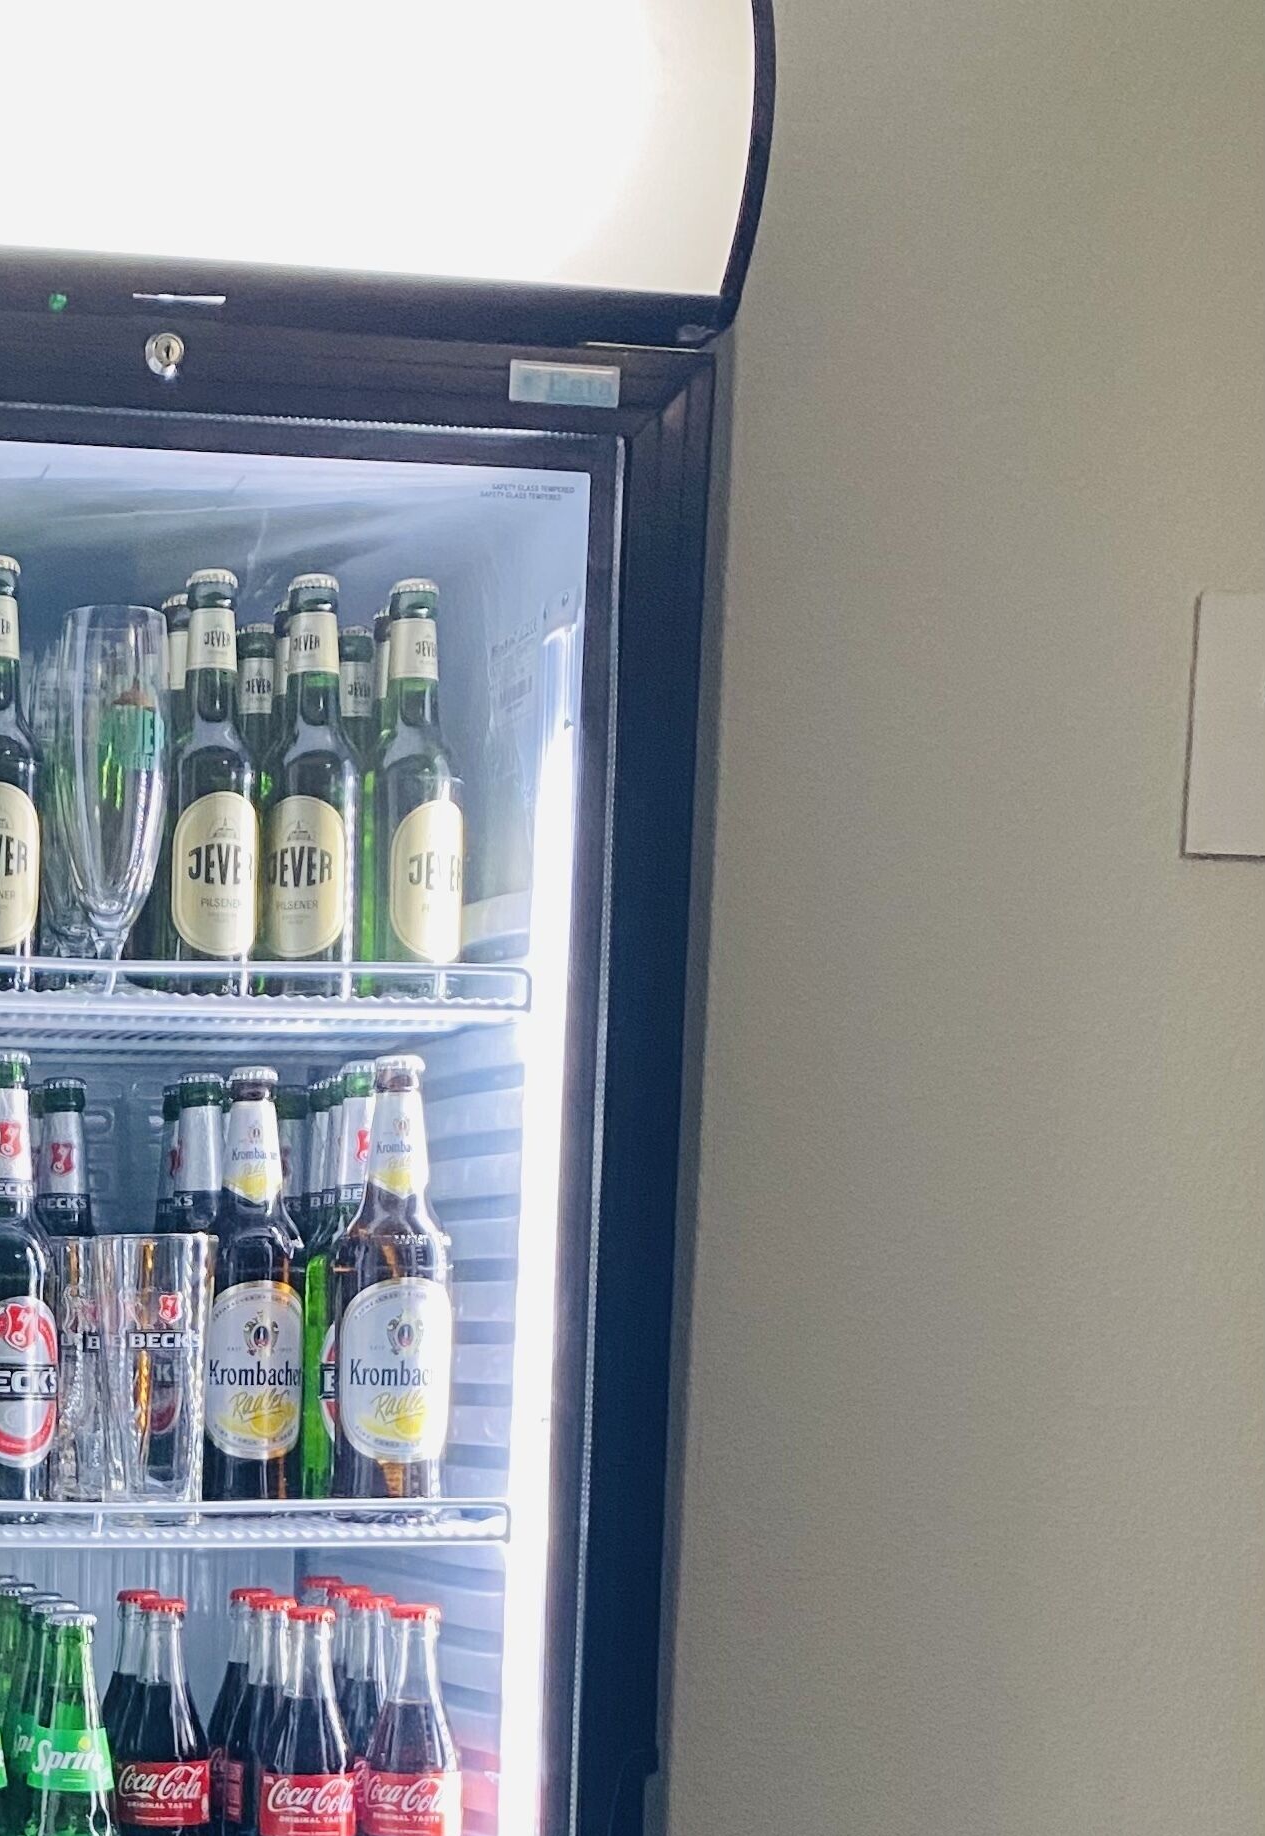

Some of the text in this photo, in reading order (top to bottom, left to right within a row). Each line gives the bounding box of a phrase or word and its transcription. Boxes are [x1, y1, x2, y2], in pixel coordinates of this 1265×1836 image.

[203, 632, 231, 648] JEVER
[293, 634, 321, 652] JEVER
[245, 678, 272, 694] JEVER
[268, 846, 333, 888] JEVER
[209, 1359, 303, 1387] Krombacher
[229, 1388, 290, 1420] Radler
[118, 1764, 204, 1800] Coca-Cola
[168, 1802, 193, 1810] TASTE
[267, 1777, 354, 1815] Coca-Cola
[278, 1815, 321, 1824] ORIGINAL
